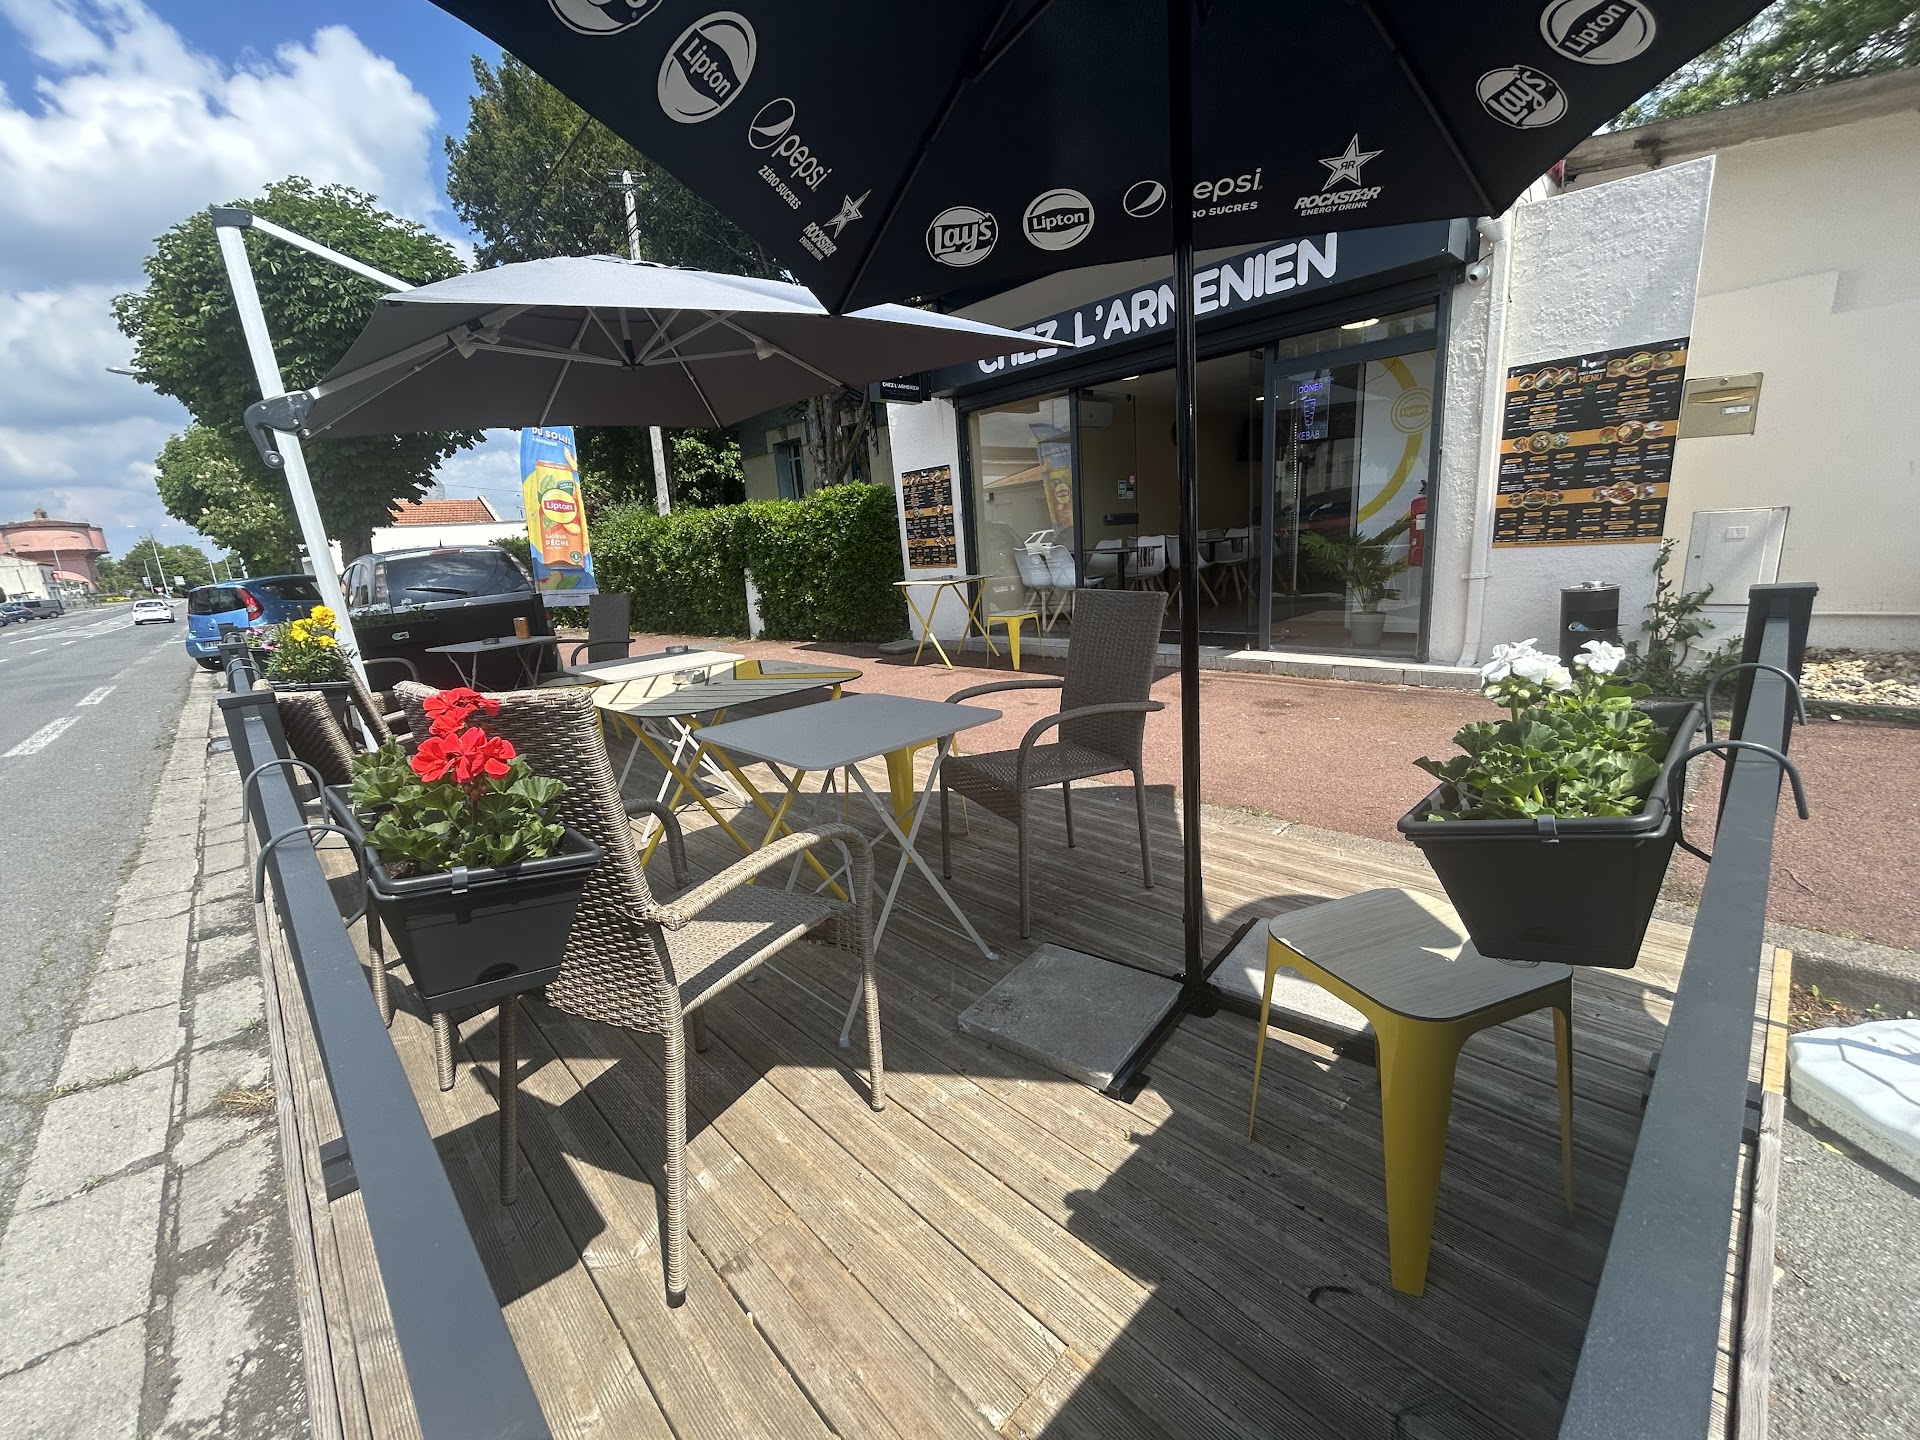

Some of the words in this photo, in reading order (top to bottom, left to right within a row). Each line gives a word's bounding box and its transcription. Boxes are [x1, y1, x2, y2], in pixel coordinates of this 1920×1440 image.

[1565, 3, 1626, 52] Lipton
[682, 37, 731, 98] Lipton
[1487, 70, 1546, 124] Lay's
[771, 134, 832, 190] pepsi
[1193, 167, 1260, 202] epsi
[776, 183, 801, 210] SUCRES
[1294, 186, 1381, 210] ROCKSTAR
[1208, 201, 1258, 215] SUCRES
[1301, 204, 1338, 216] ENERGY
[1338, 201, 1368, 212] DRINK
[1032, 212, 1085, 230] Lipton
[934, 217, 992, 254] Lay's
[1298, 382, 1323, 394] DÖNER
[1579, 373, 1603, 384] MENU
[1296, 430, 1320, 441] KEBAB
[546, 501, 573, 510] Lipton
[545, 538, 570, 546] PÊCHE
